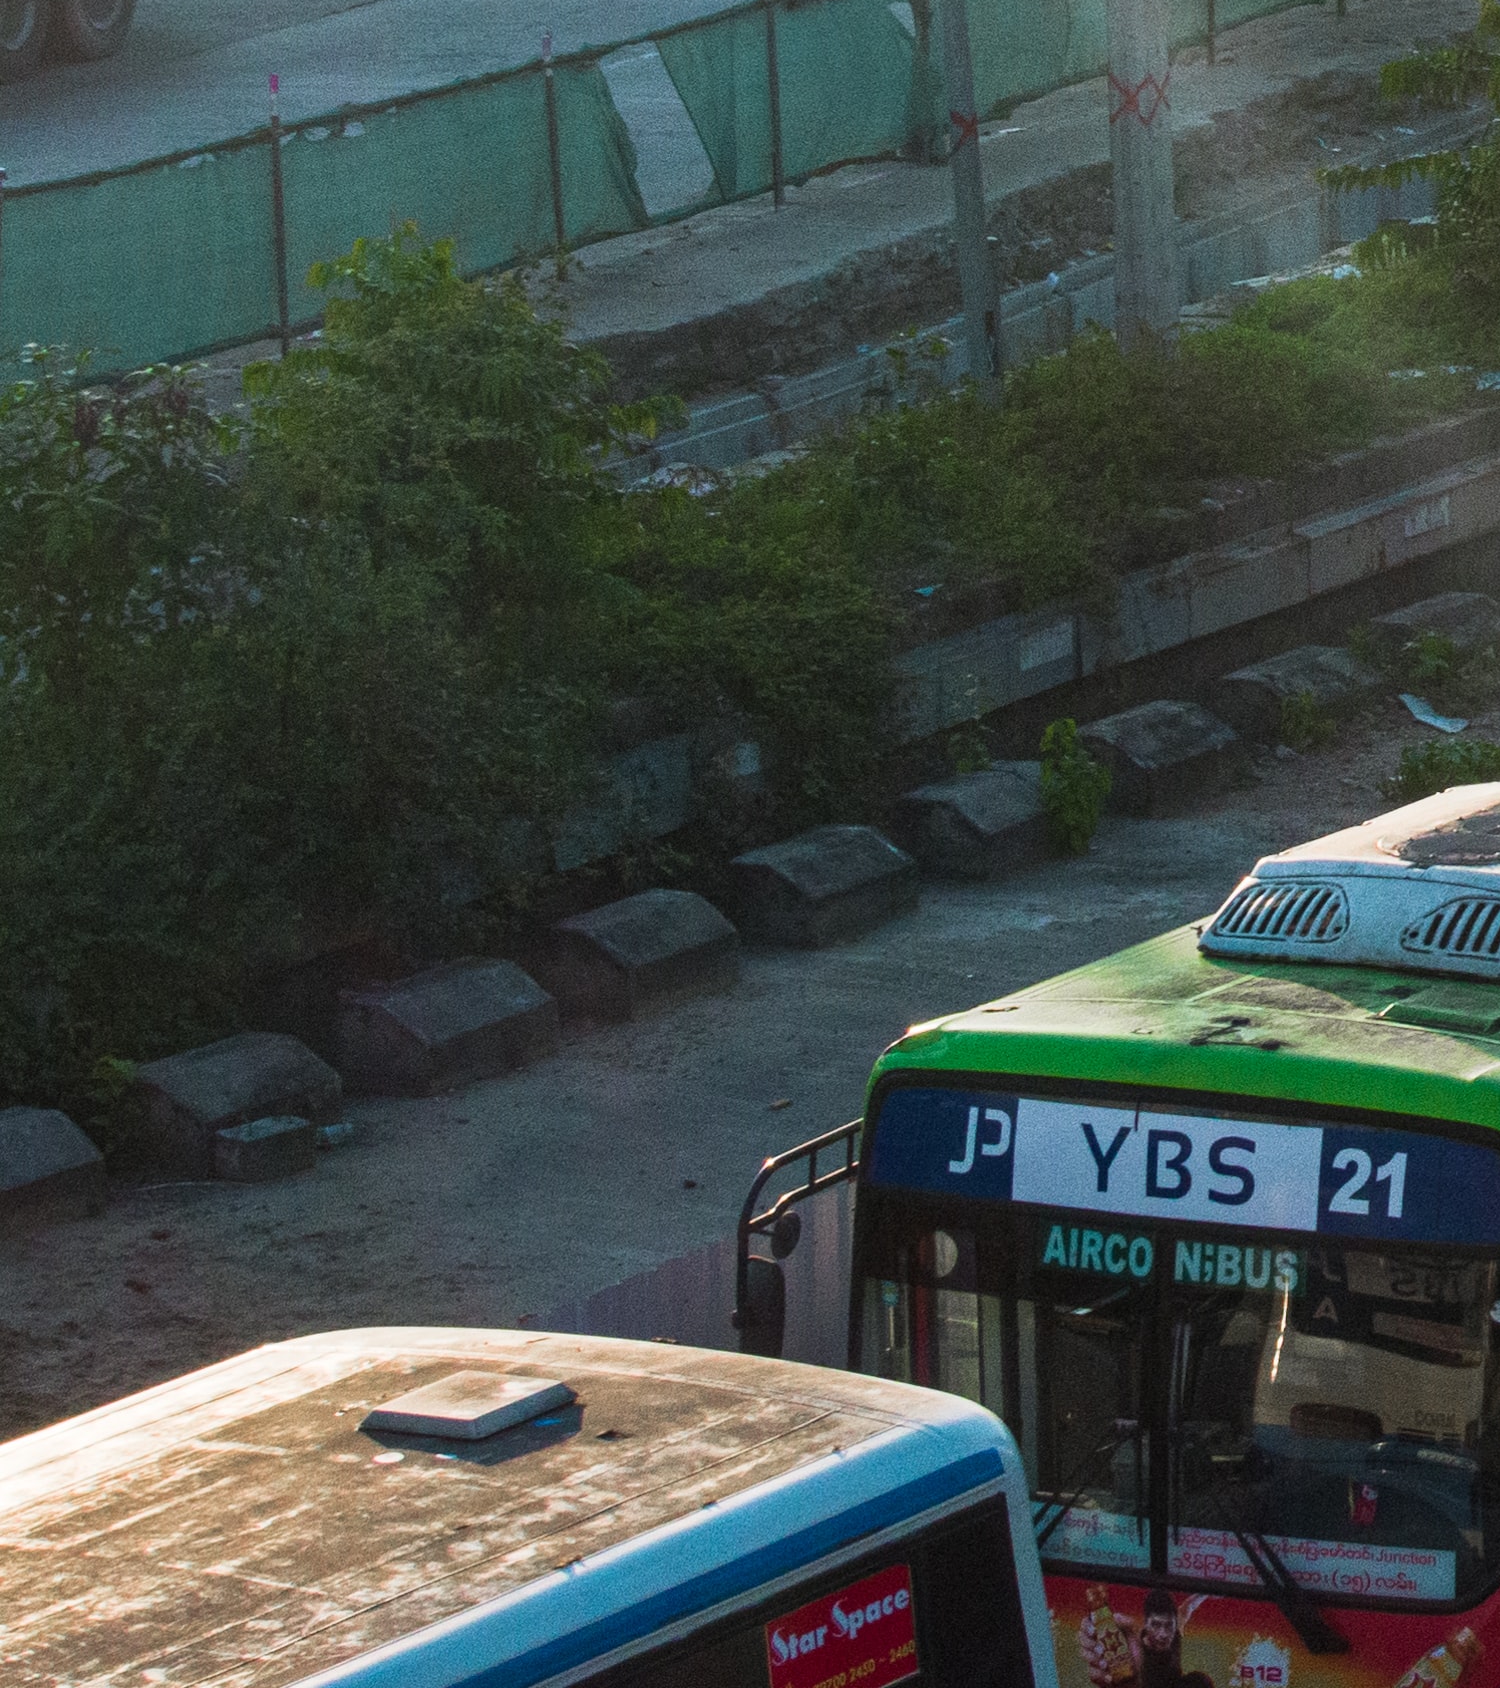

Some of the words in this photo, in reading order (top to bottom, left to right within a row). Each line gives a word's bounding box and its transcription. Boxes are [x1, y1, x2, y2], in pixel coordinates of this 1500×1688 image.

[1082, 1122, 1256, 1206] YBS
[1329, 1147, 1409, 1219] 21
[1044, 1224, 1156, 1279] AIRCO
[772, 1626, 829, 1667] Star
[832, 1588, 911, 1640] Space
